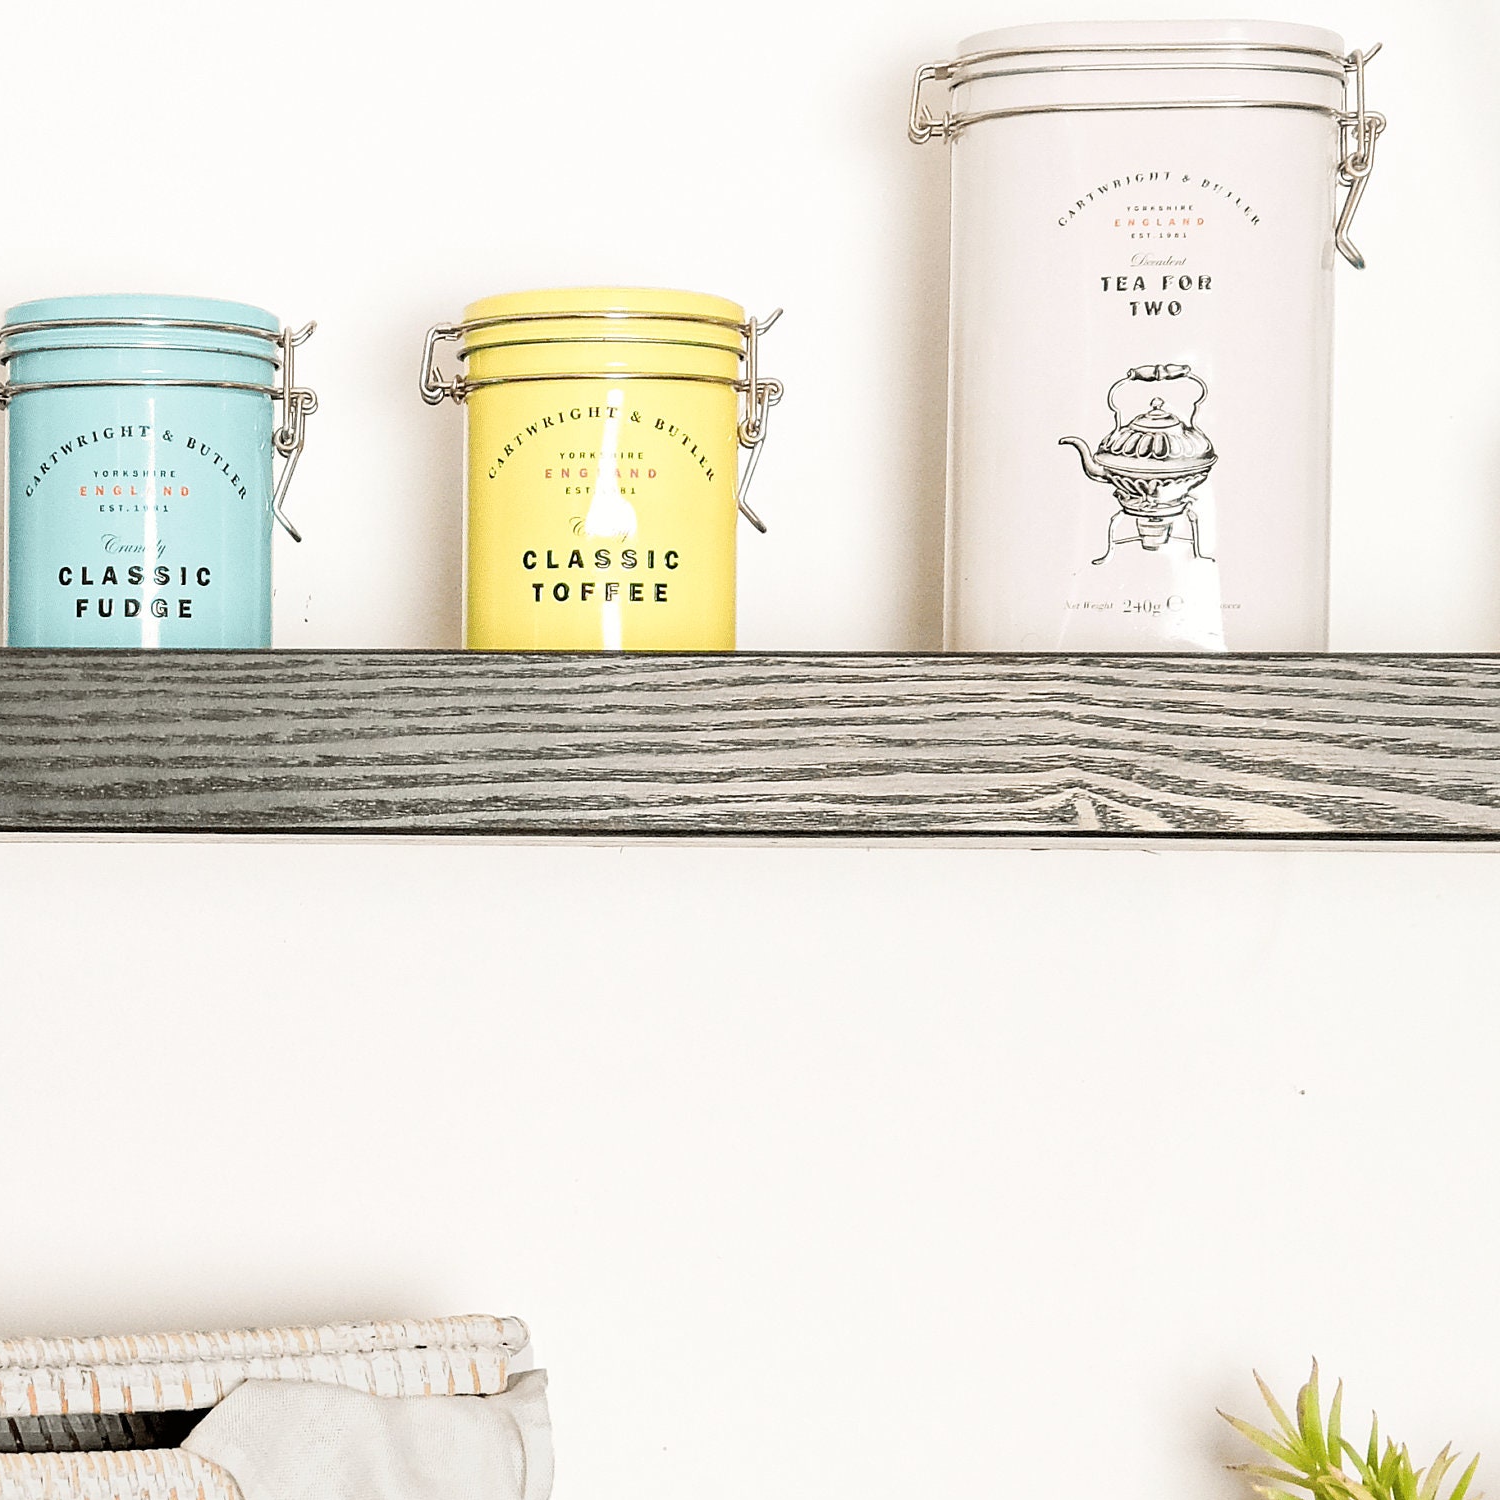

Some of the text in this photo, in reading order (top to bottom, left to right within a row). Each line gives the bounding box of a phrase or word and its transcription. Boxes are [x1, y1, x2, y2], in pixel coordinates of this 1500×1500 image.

[1058, 171, 1260, 226] CARTWRIGHT & BUTLER
[1114, 217, 1204, 227] ENGLAND
[1101, 274, 1212, 291] TEA FOR
[1129, 300, 1182, 316] TWO
[488, 406, 715, 482] CARTWRIGHT & BUTLER
[25, 425, 247, 500] CARTWRIGHT & BUTLER
[560, 452, 643, 460] YORKIRE
[79, 485, 190, 497] ENGLND
[522, 549, 679, 569] CLASSIC
[58, 565, 211, 586] CLASSIC
[532, 582, 668, 602] TOFFEE
[76, 598, 193, 618] FUDGE
